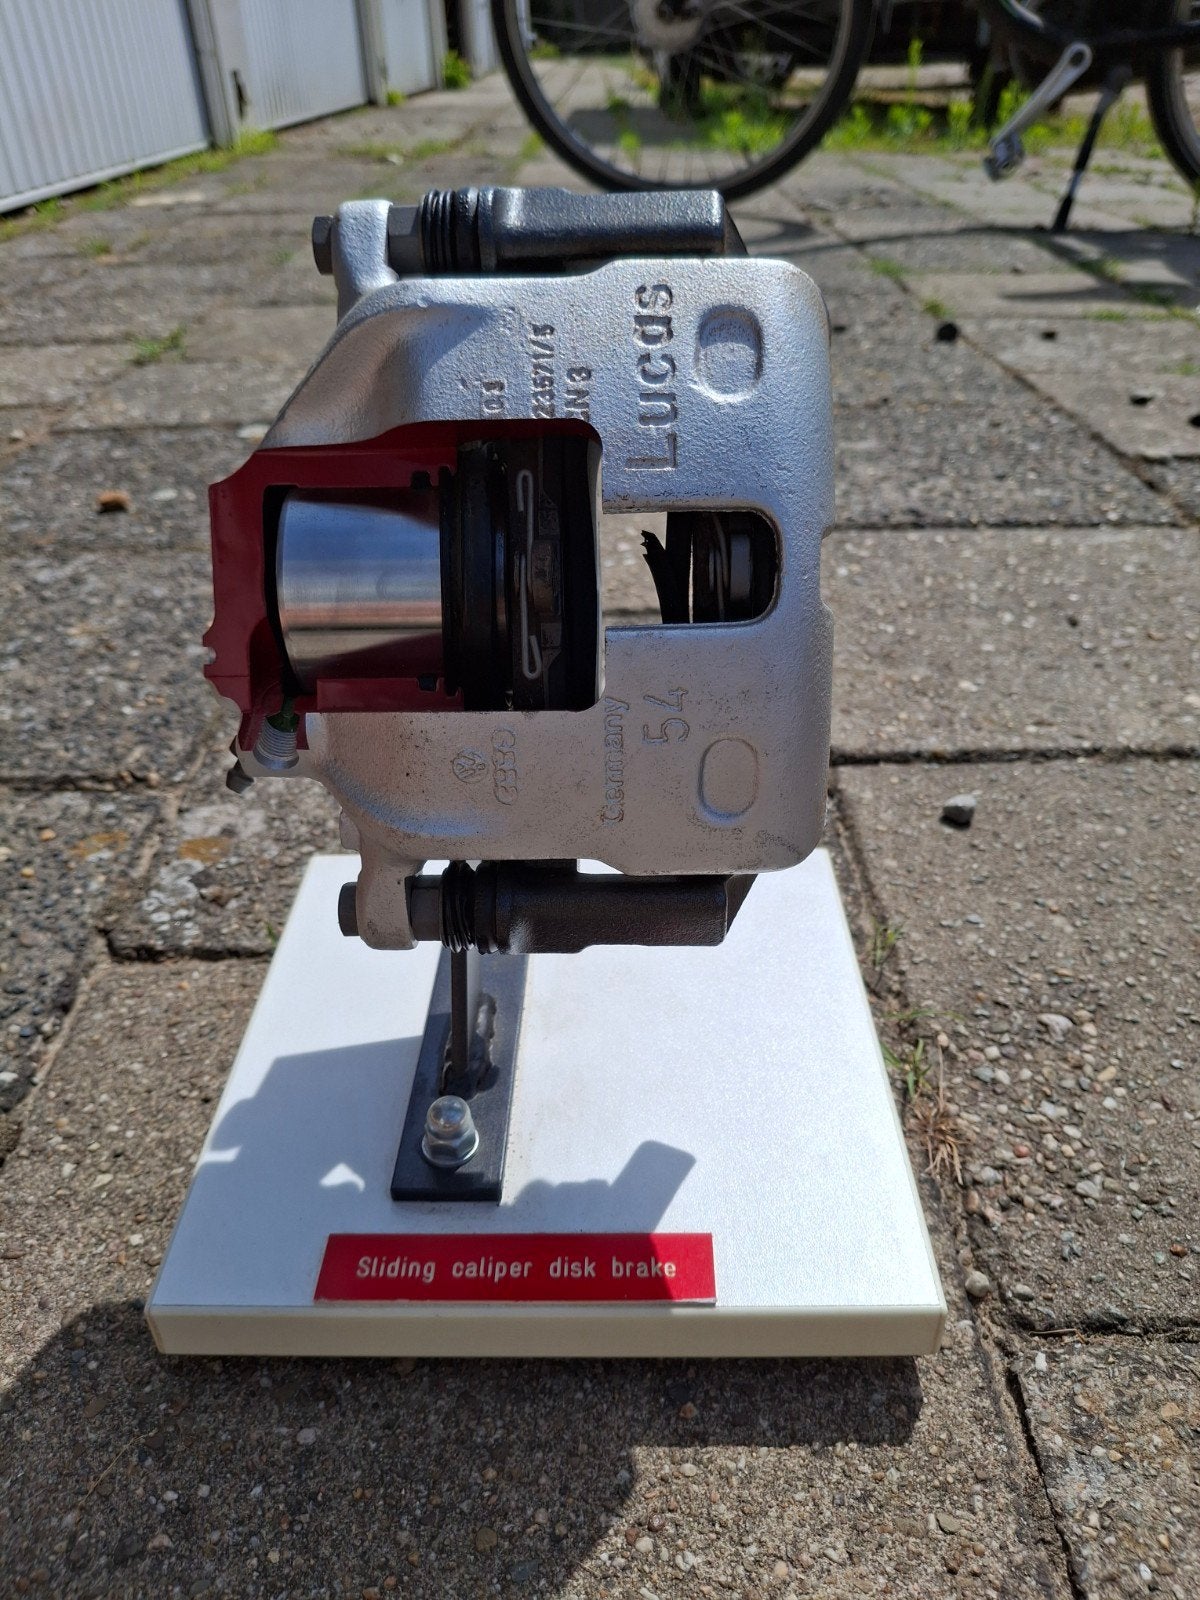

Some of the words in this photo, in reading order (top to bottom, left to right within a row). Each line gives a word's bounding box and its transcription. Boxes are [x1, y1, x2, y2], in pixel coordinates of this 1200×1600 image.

[626, 283, 677, 471] Lucas
[601, 696, 630, 823] Germany
[643, 687, 690, 744] 54
[355, 1255, 436, 1283] Sliding
[452, 1255, 533, 1282] caliper
[549, 1255, 596, 1278] disk
[612, 1255, 677, 1278] brake
